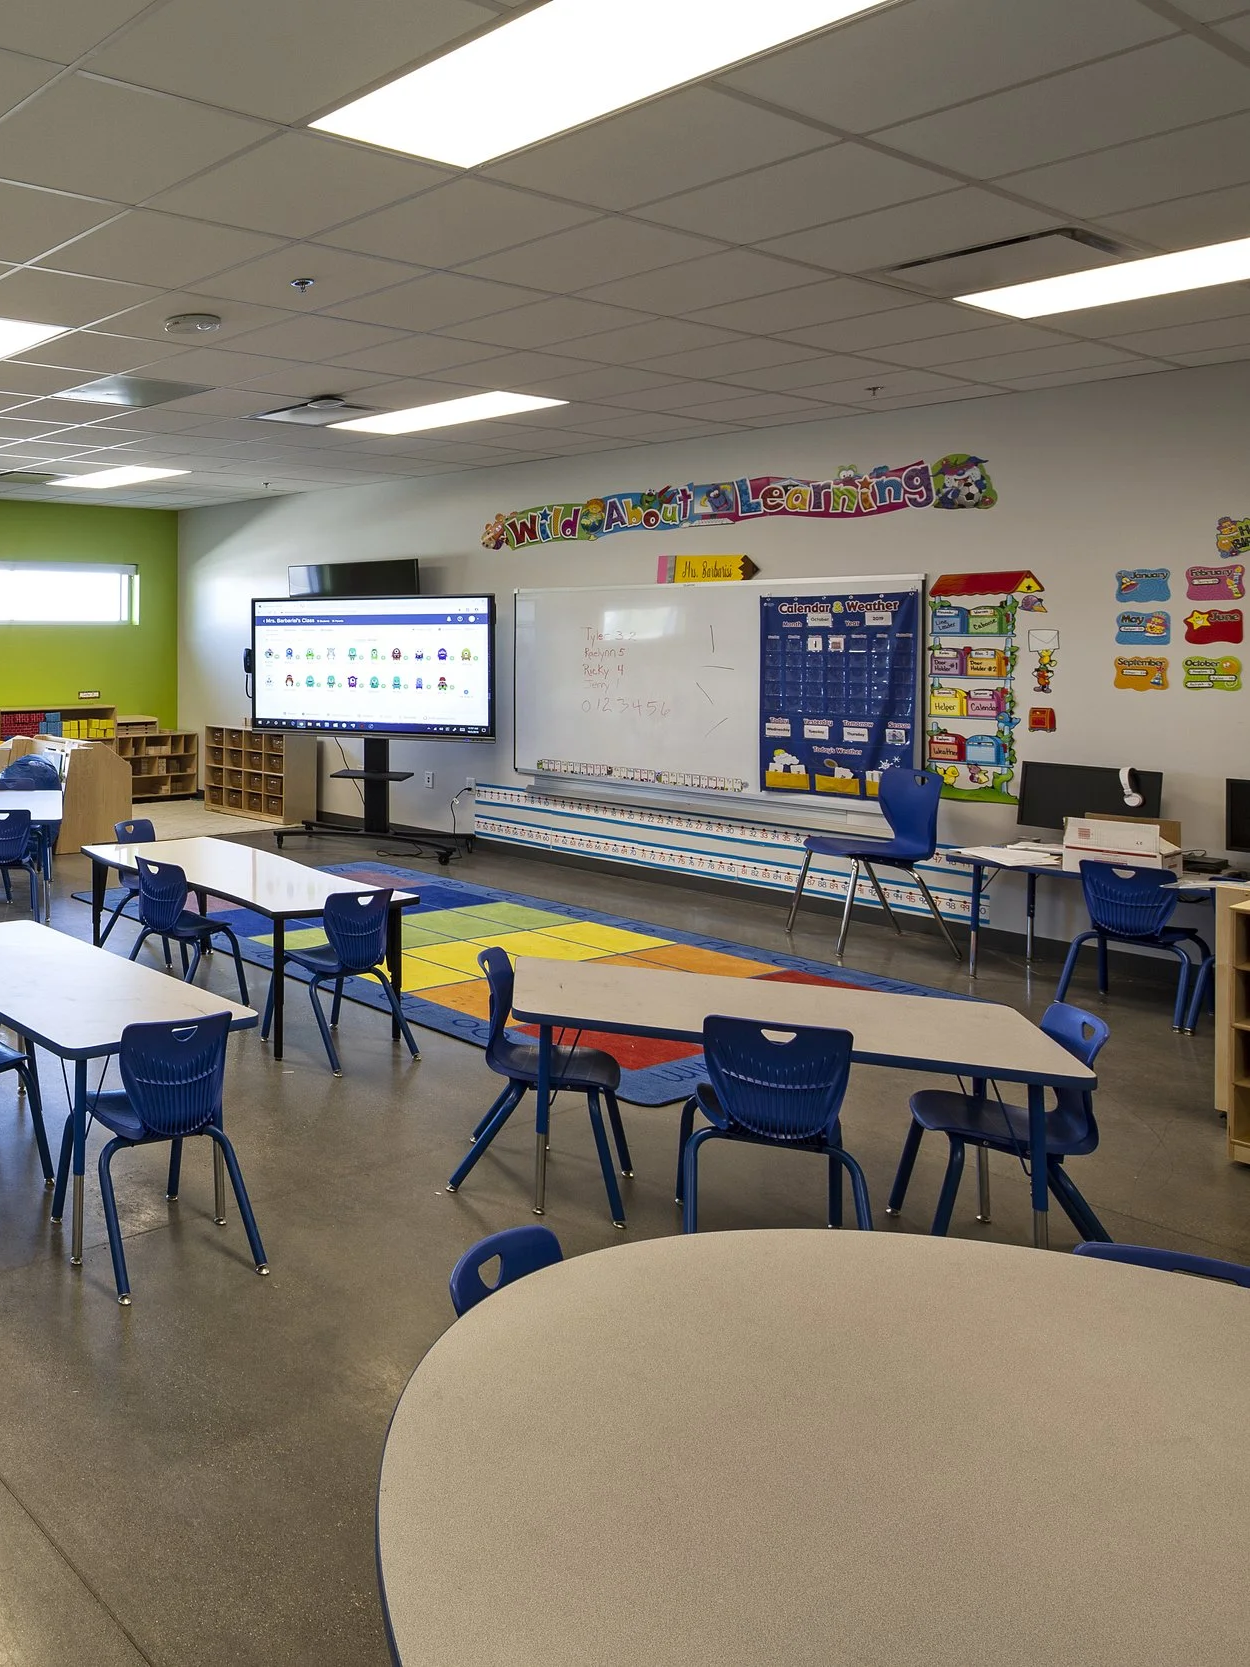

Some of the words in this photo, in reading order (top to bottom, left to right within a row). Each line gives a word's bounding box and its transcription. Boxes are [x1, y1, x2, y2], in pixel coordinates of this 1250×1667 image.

[506, 506, 580, 547] Wild
[603, 488, 693, 532] About
[734, 463, 936, 516] Learning
[682, 561, 698, 578] Mrs.
[1190, 569, 1233, 577] February
[1130, 571, 1168, 580] January
[779, 601, 830, 614] Calendar
[832, 601, 843, 613] &
[845, 600, 899, 612] Weather
[1120, 615, 1144, 625] May
[1210, 612, 1239, 622] June
[618, 648, 626, 656] 5
[1117, 658, 1164, 667] September
[1185, 659, 1220, 667] October
[617, 664, 624, 676] 4
[582, 700, 591, 712] 0
[617, 698, 630, 714] 3
[632, 699, 642, 716] 4
[646, 701, 658, 716] 5
[935, 703, 956, 712] Helper
[970, 703, 998, 711] Calendar
[961, 904, 969, 912] 99
